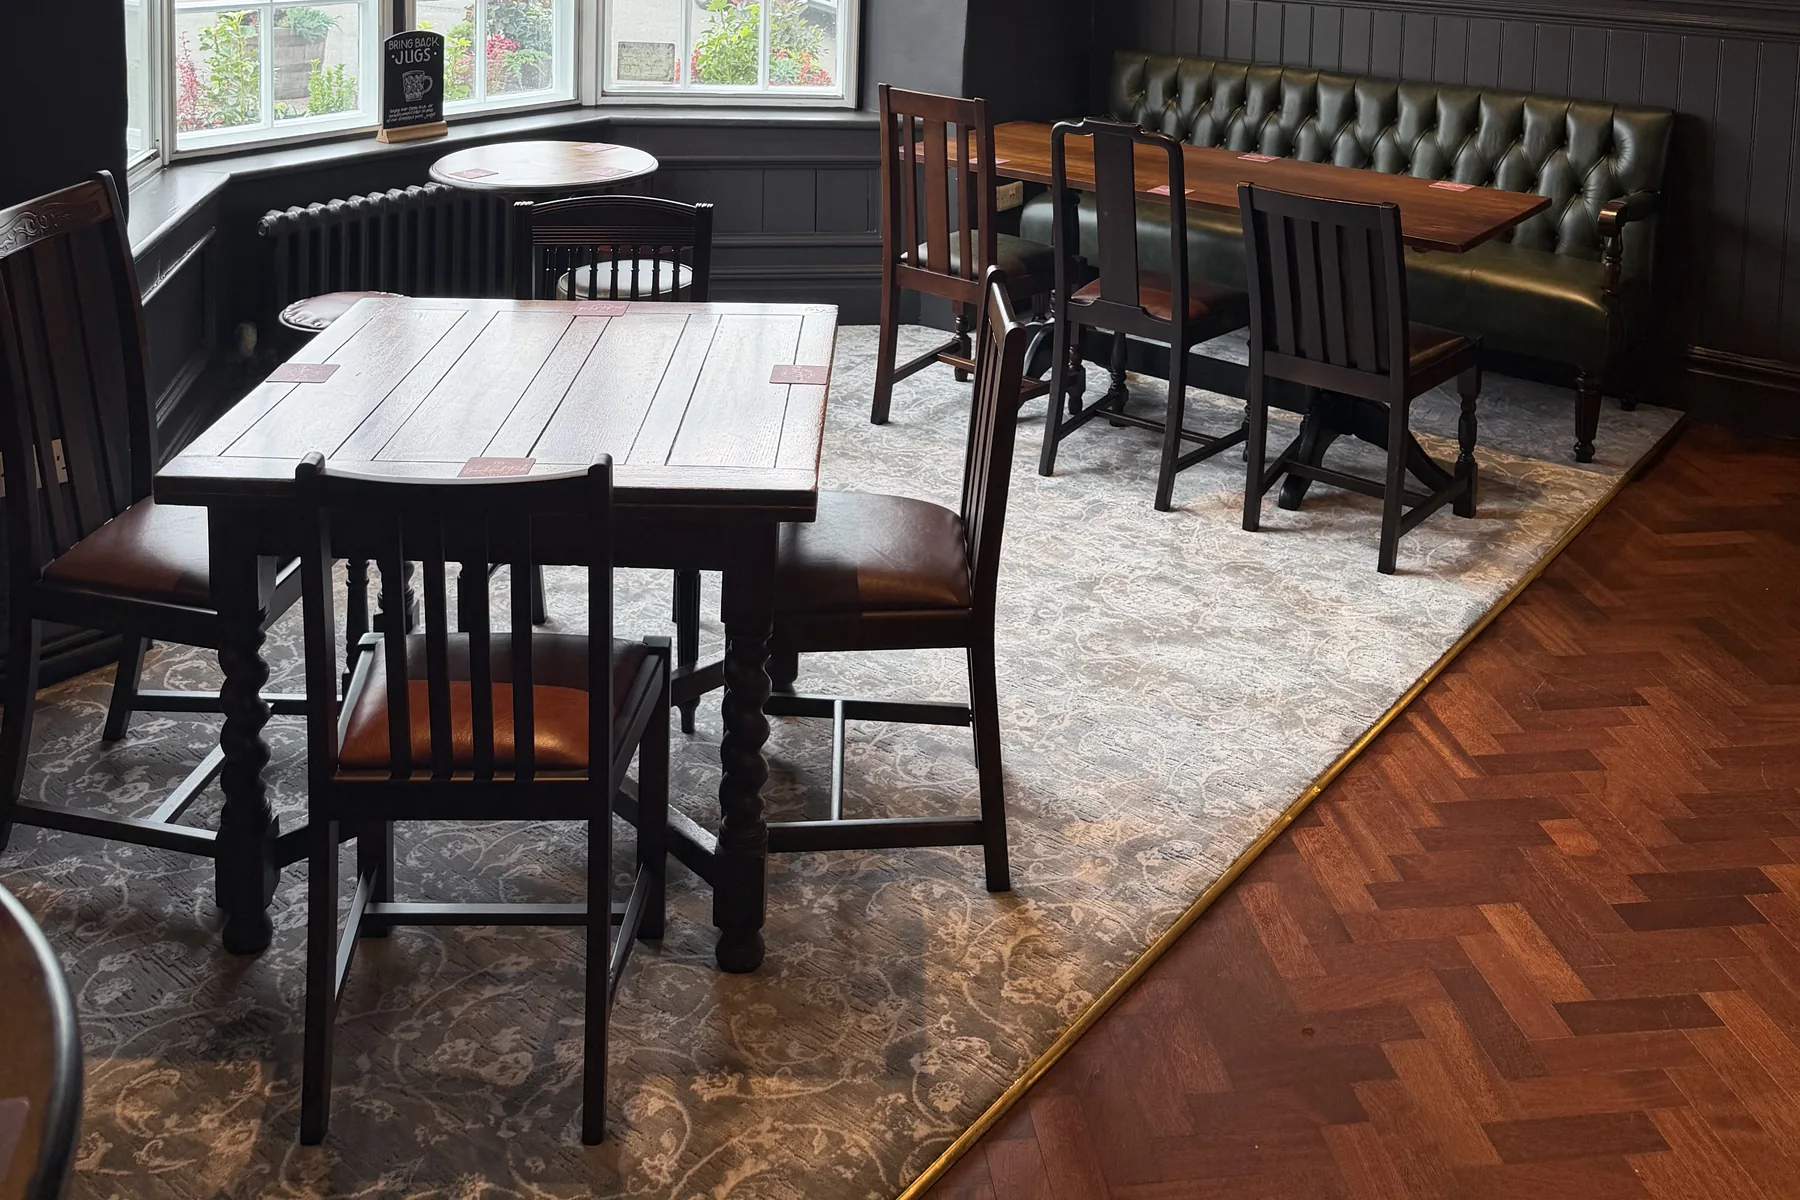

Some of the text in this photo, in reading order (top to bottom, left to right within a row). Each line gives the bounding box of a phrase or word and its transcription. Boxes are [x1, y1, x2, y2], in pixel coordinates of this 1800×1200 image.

[388, 36, 440, 50] BRING BACK
[395, 48, 430, 64] JUGS
